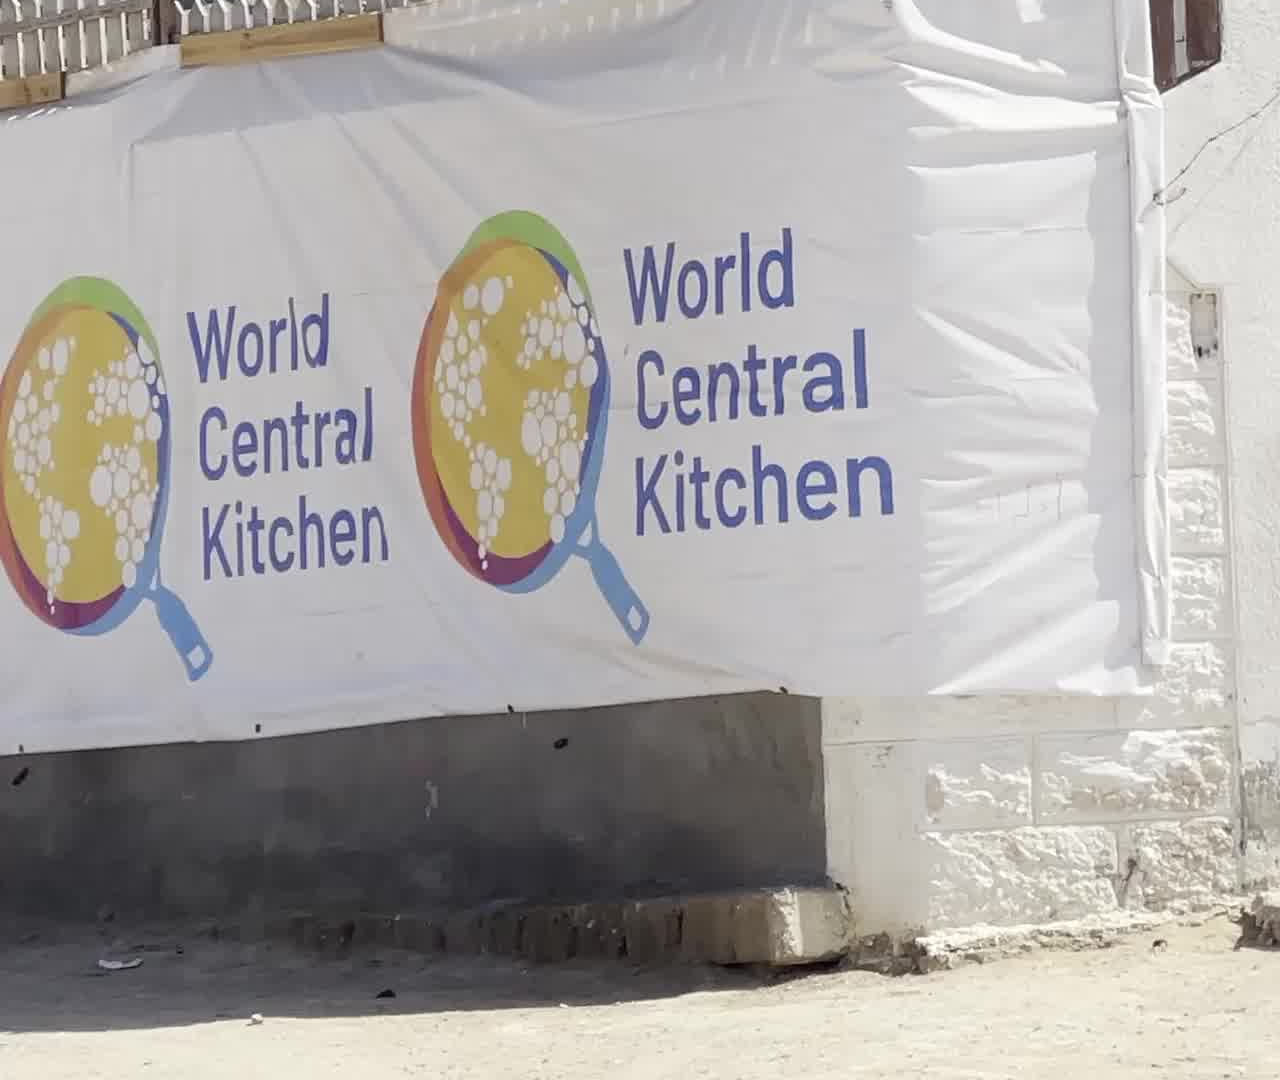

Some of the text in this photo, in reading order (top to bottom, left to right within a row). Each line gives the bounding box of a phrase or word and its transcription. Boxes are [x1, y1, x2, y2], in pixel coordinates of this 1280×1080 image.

[623, 227, 795, 326] World
[187, 292, 329, 384] World
[636, 328, 869, 430] Central
[199, 387, 373, 481] Central
[202, 495, 389, 581] Kitchen
[635, 447, 894, 537] Kitchen
